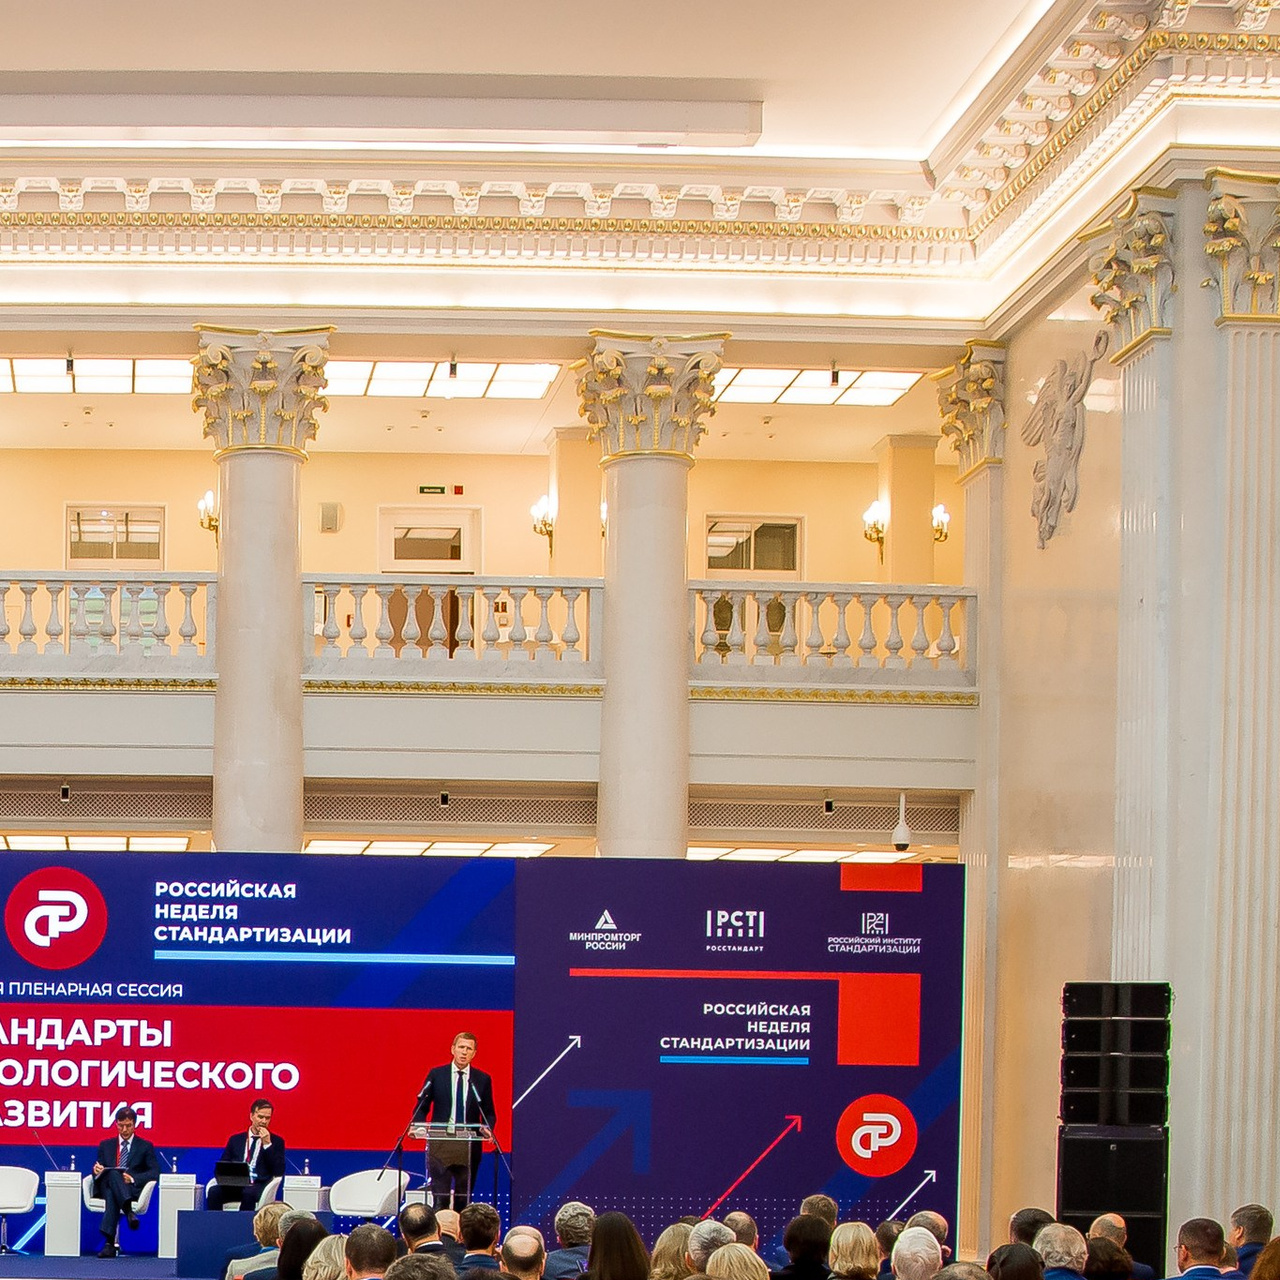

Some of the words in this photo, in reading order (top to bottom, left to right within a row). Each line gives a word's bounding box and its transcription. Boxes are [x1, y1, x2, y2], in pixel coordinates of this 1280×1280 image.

[155, 879, 297, 899] РОССИЙСКАЯ
[154, 903, 238, 922] НЕДЕЛЯ
[153, 925, 351, 946] СТАНДАРТИЗАЦИИ
[569, 932, 642, 942] МИНПРОМТОРГ
[827, 936, 881, 944] РОССИЙСКИЙ
[881, 937, 922, 945] ИНСТИТУТ
[585, 941, 626, 951] РОССИИ
[705, 945, 764, 953] РОССТАНДАРТ
[827, 944, 921, 955] СТАНДАРТИЗАЦИИ
[8, 981, 113, 997] ПЛЕНАРНАЯ
[116, 983, 183, 998] СЕССИЯ
[703, 1001, 811, 1016] РОССИЙСКАЯ
[747, 1021, 811, 1035] НЕДЕЛЯ
[660, 1036, 811, 1052] СТАНДАРТИЗАЦИИ
